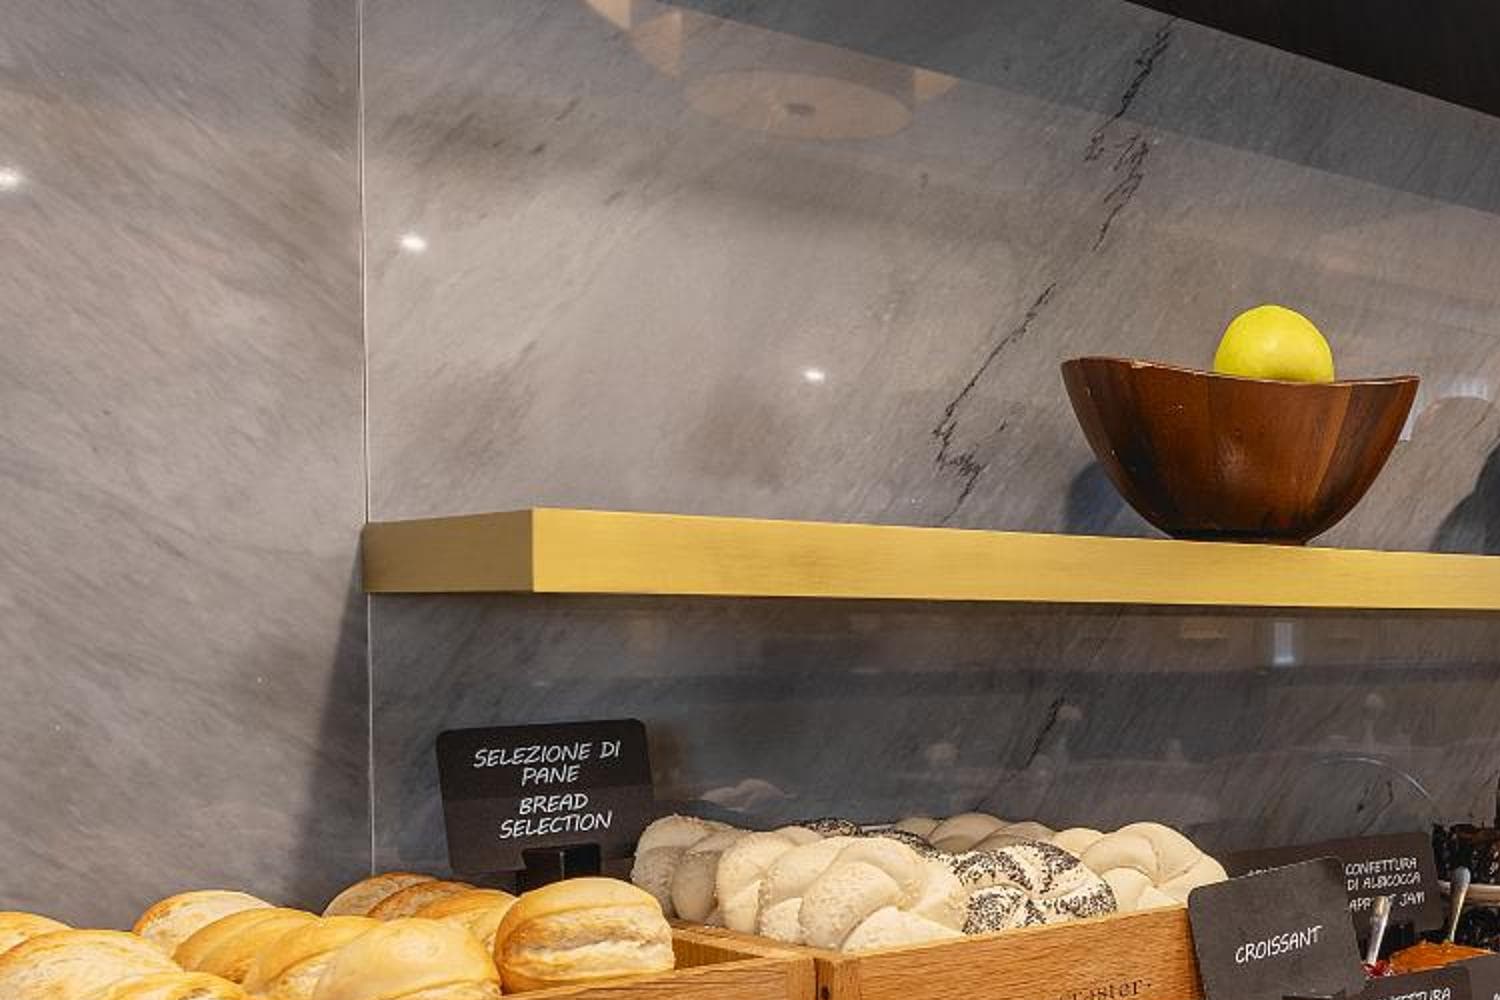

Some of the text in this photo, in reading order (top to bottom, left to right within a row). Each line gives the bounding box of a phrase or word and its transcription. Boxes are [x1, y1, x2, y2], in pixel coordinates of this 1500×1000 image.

[473, 740, 621, 768] SELEZIONE DI
[521, 764, 581, 787] PANE
[519, 793, 589, 815] BREAD
[499, 810, 613, 839] SELECTION
[1345, 856, 1417, 876] CONFETTURA
[1347, 878, 1359, 892] DI
[1400, 892, 1425, 907] JAM
[1235, 925, 1324, 964] CROISSANT
